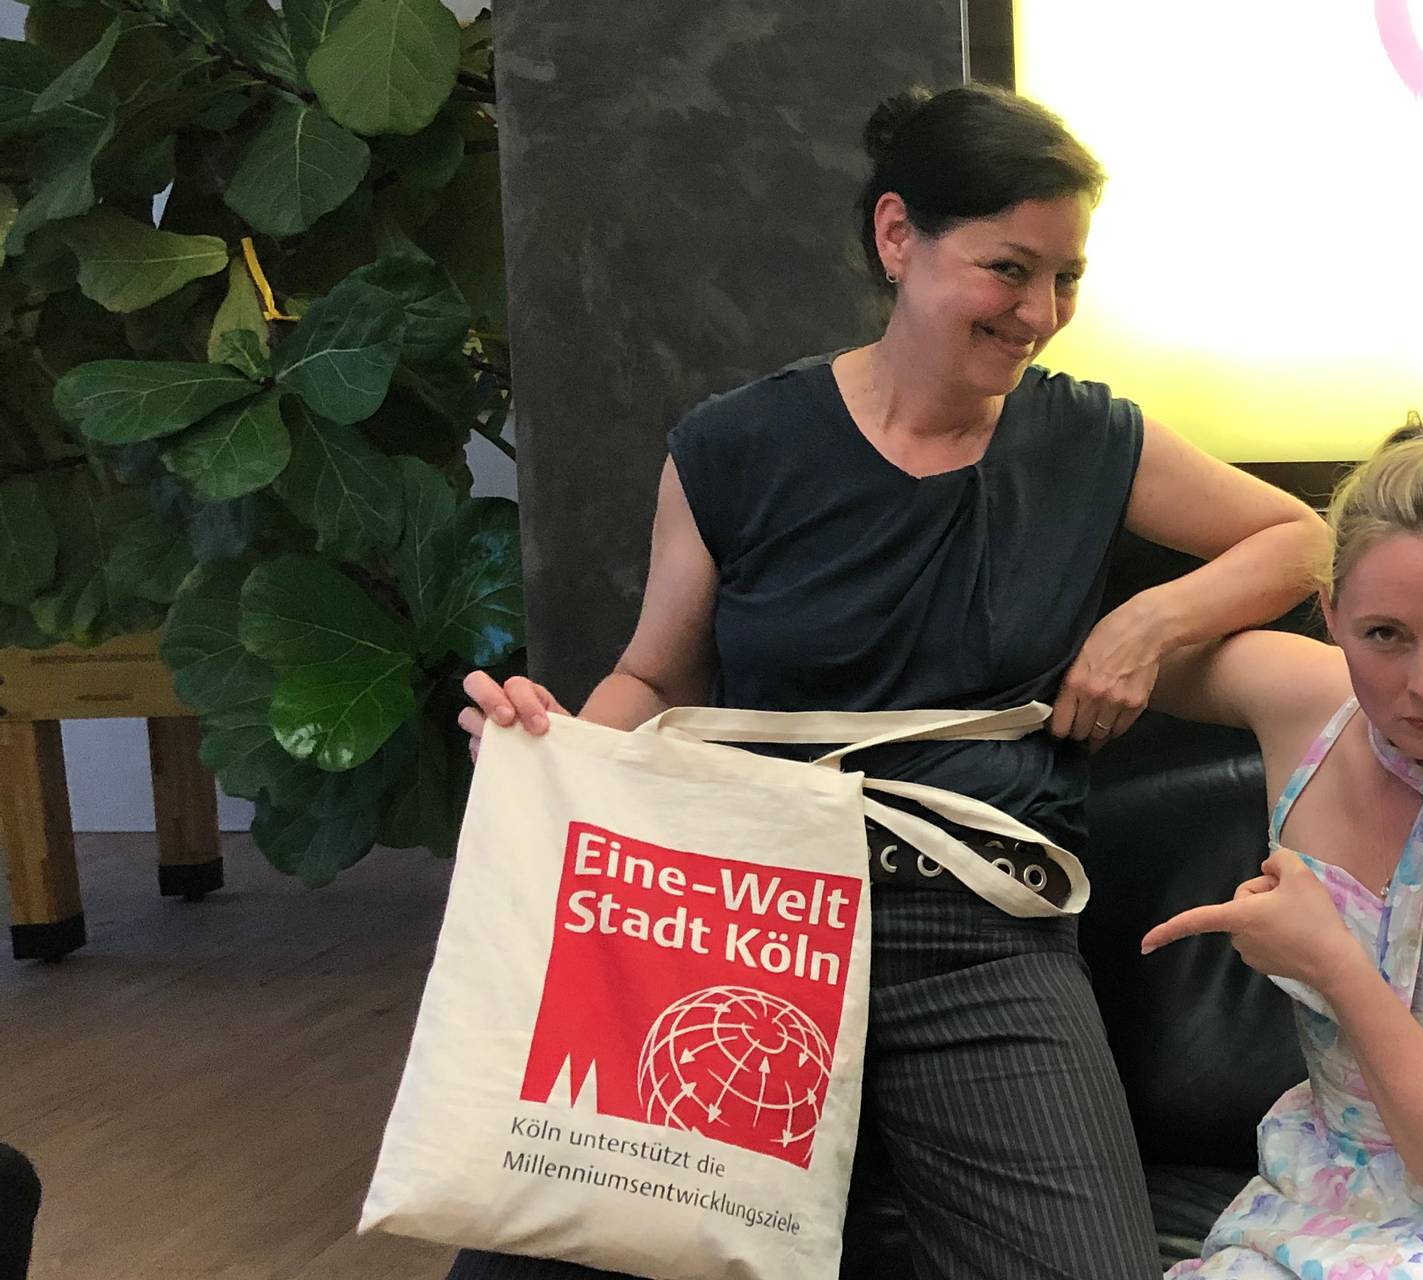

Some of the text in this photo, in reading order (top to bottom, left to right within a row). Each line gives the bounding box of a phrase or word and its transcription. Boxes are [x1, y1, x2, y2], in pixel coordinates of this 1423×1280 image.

[574, 832, 850, 929] Eine-Welt
[564, 890, 841, 986] Stadt Köln
[510, 1116, 726, 1178] Köln unterstützt die
[502, 1150, 801, 1236] Millenniumsentwicklungsziele
